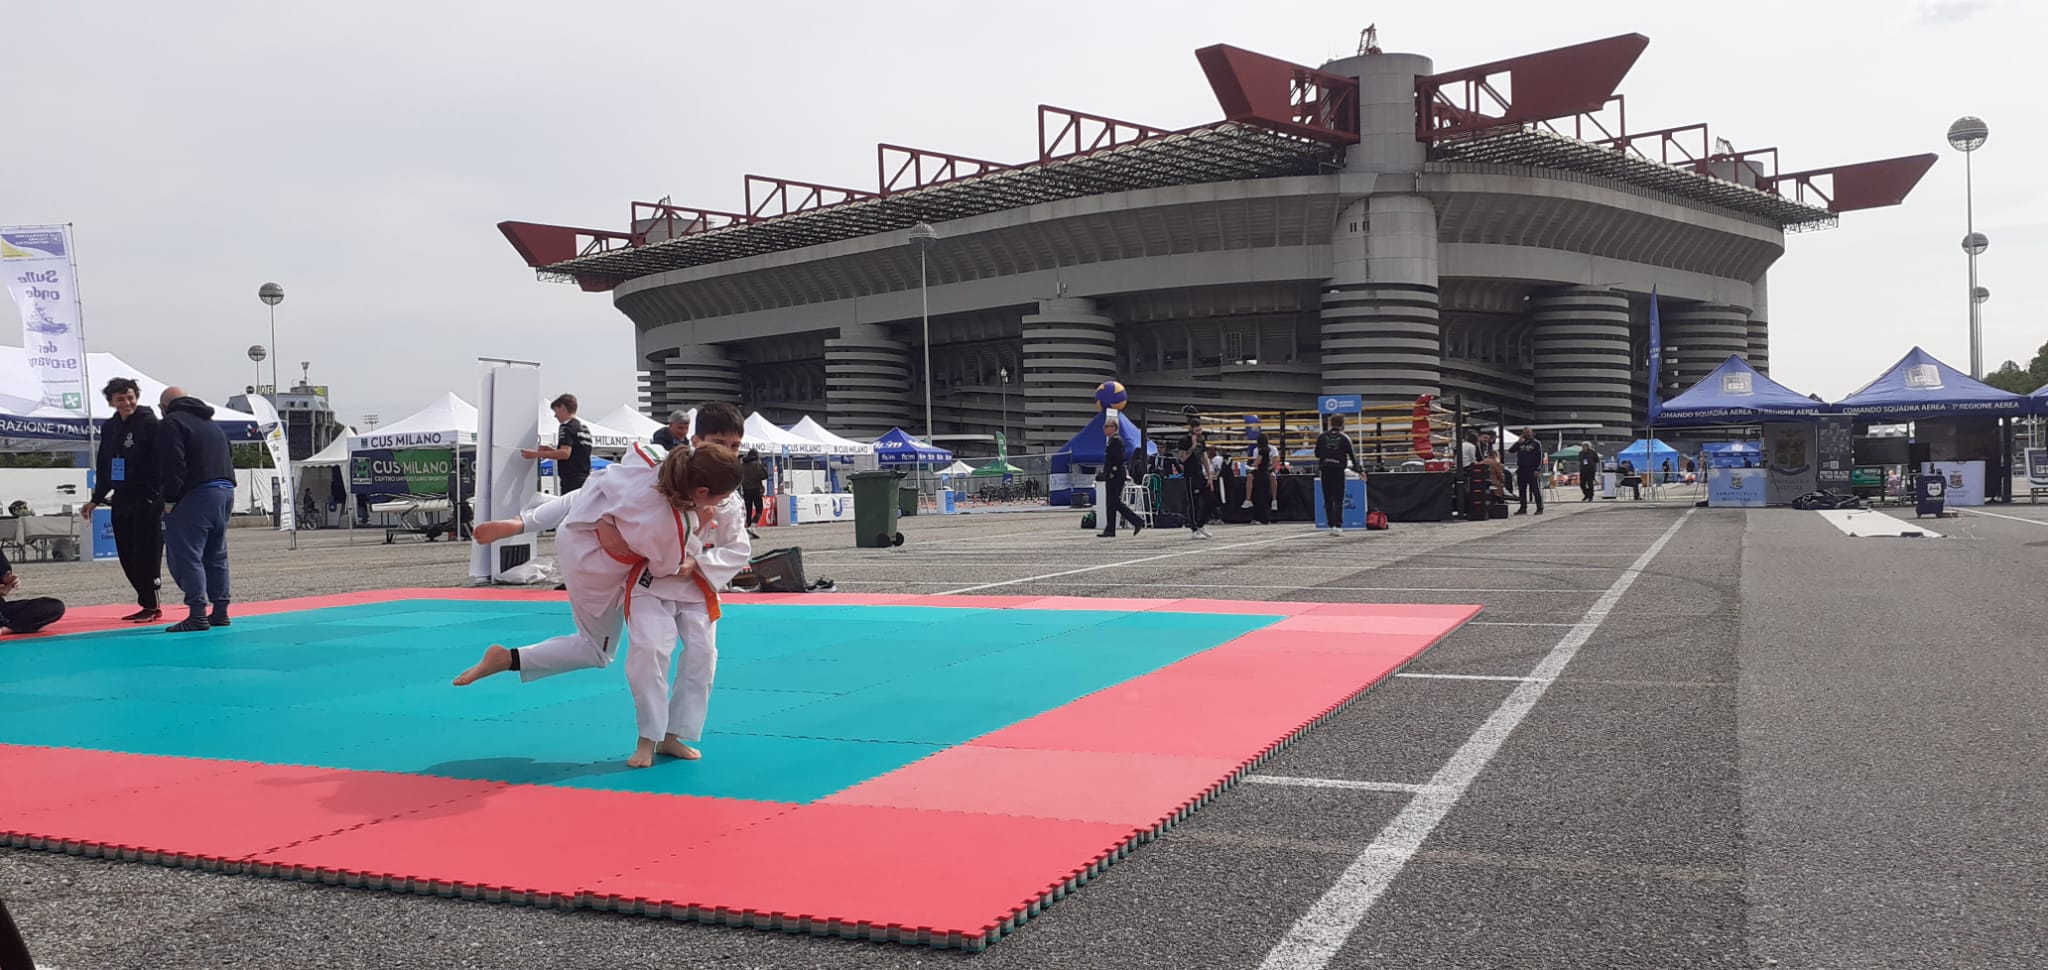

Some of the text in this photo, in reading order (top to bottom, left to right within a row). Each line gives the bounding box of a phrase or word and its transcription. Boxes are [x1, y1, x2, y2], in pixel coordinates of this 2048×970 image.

[256, 385, 276, 395] HOTE
[1842, 406, 1882, 414] COMANDO
[1883, 405, 1920, 413] SQUADRA
[1921, 403, 1946, 411] AEREA
[1959, 402, 1993, 410] REGIONE
[1994, 401, 2020, 409] AEREA
[1694, 410, 1729, 418] SQUADRA
[371, 432, 442, 448] CUS MILANO
[594, 436, 628, 446] MILANO
[740, 442, 766, 451] MILANO
[799, 444, 822, 453] MILANO
[849, 446, 868, 454] MILANO
[373, 460, 448, 474] CUS MILANO
